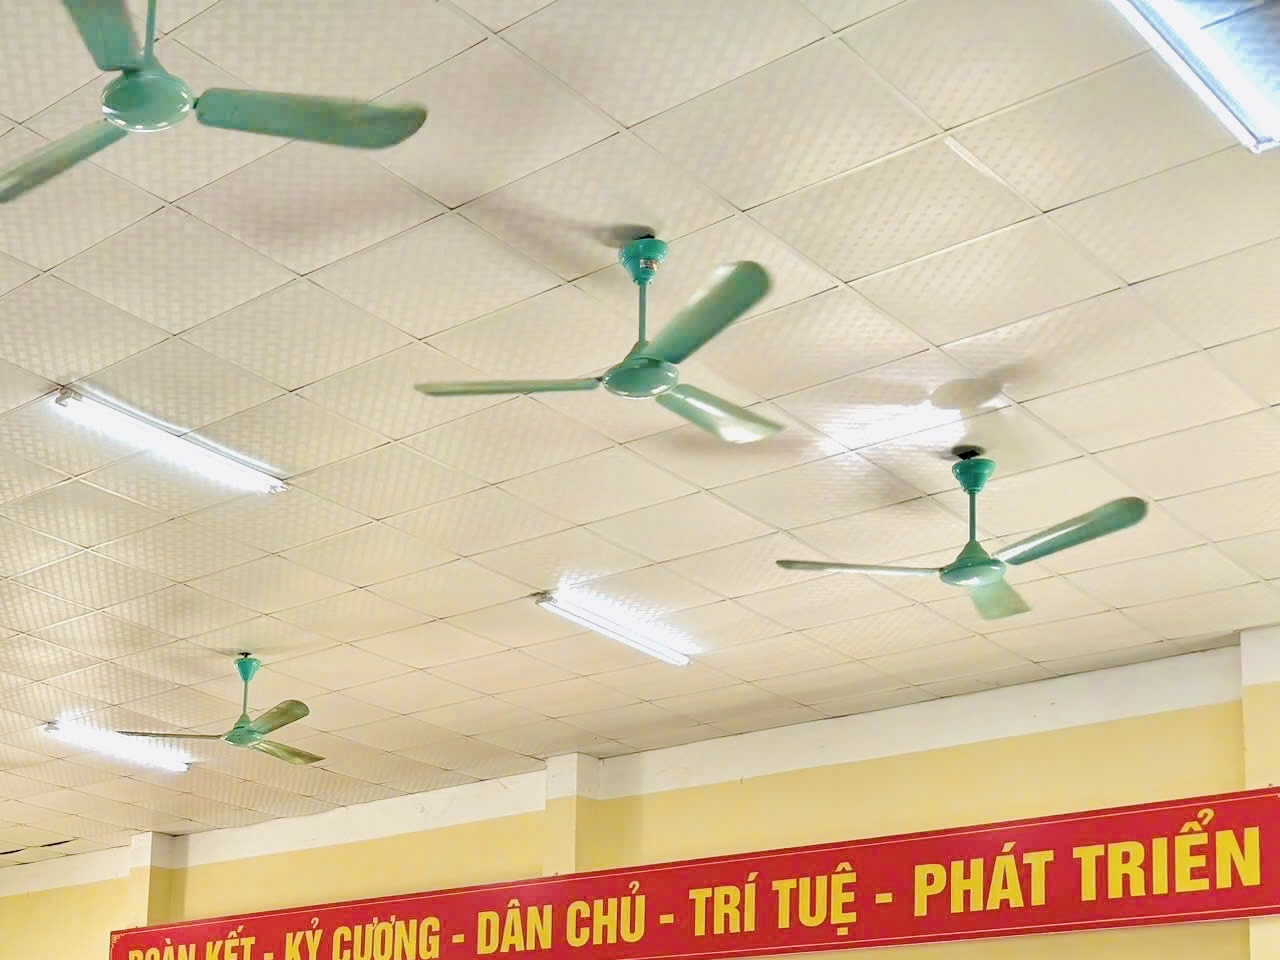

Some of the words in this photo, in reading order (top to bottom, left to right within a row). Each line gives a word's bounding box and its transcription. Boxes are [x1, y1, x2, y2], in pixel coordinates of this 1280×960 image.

[477, 899, 552, 955] DÂN
[566, 880, 646, 947] CHỦ
[688, 871, 759, 937] TRÍ
[772, 862, 857, 936] TUỆ
[914, 841, 1055, 917] PHÁT
[1073, 808, 1262, 902] TRIỂN
